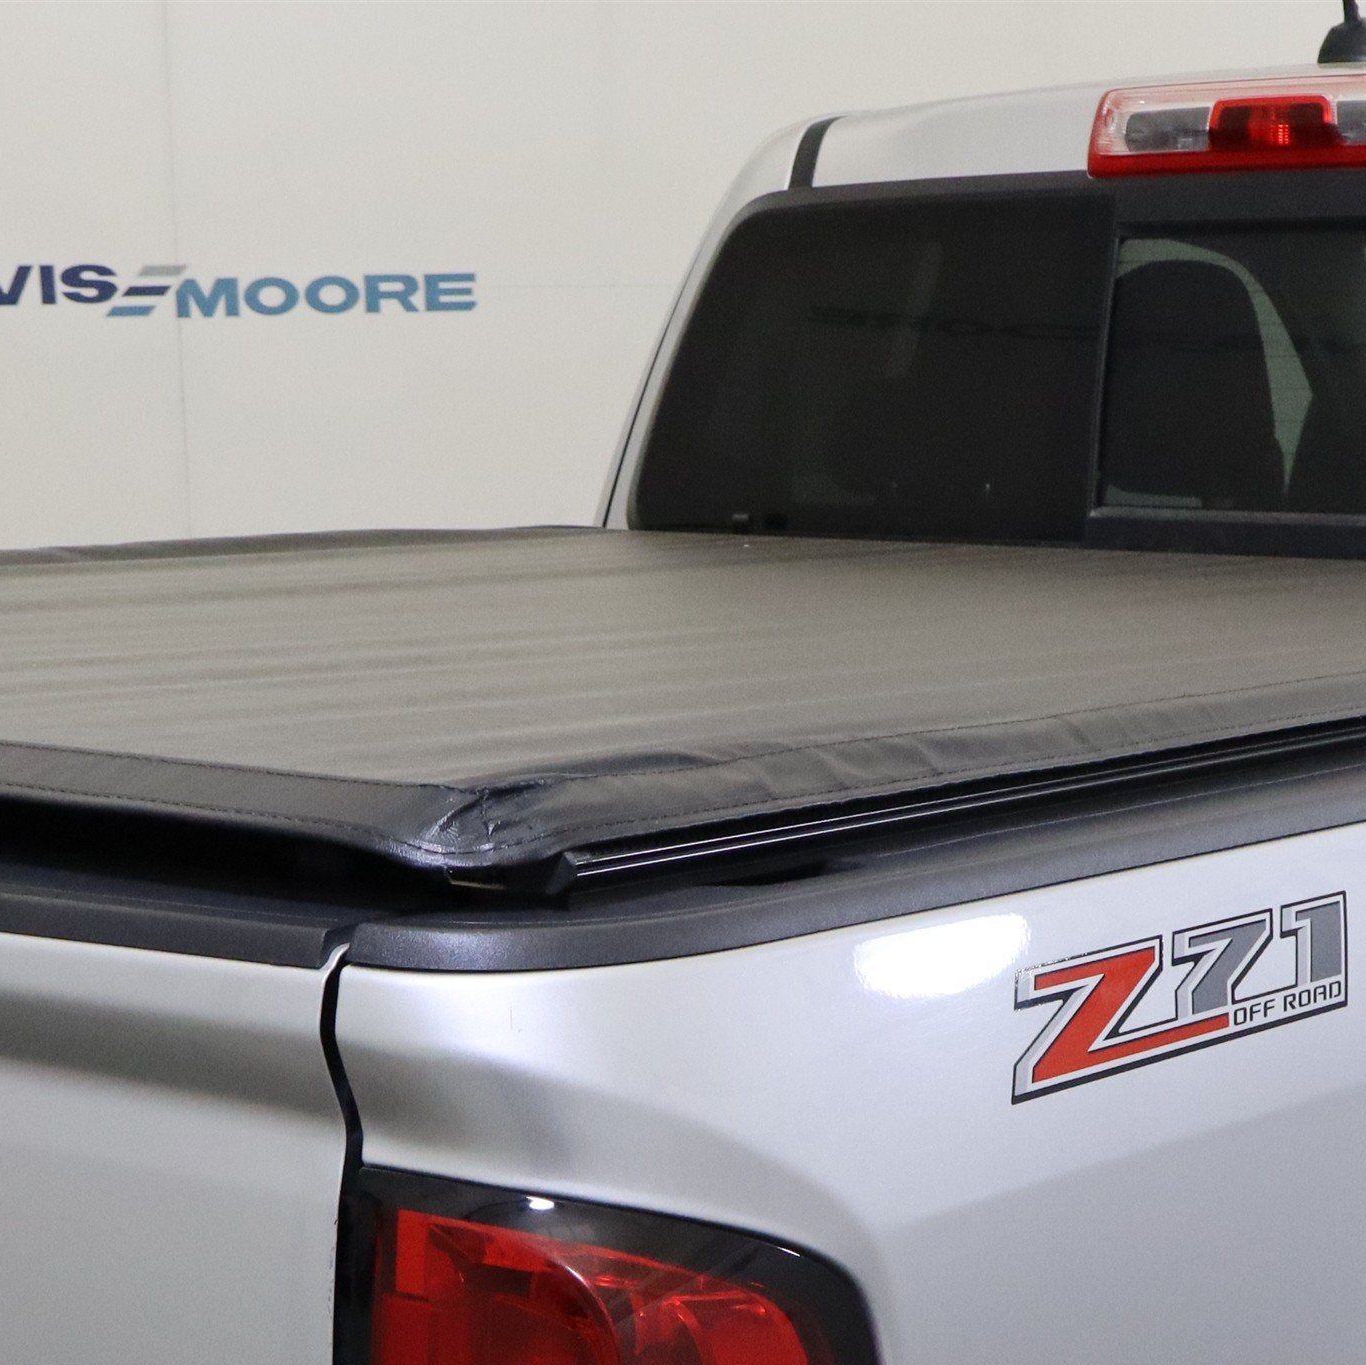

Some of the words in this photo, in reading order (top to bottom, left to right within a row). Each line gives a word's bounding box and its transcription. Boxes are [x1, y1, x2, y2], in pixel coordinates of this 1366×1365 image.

[175, 272, 477, 318] MOORE
[1011, 890, 1349, 1105] Z71
[1233, 1004, 1276, 1026] OFF
[1282, 980, 1343, 1012] ROAD
